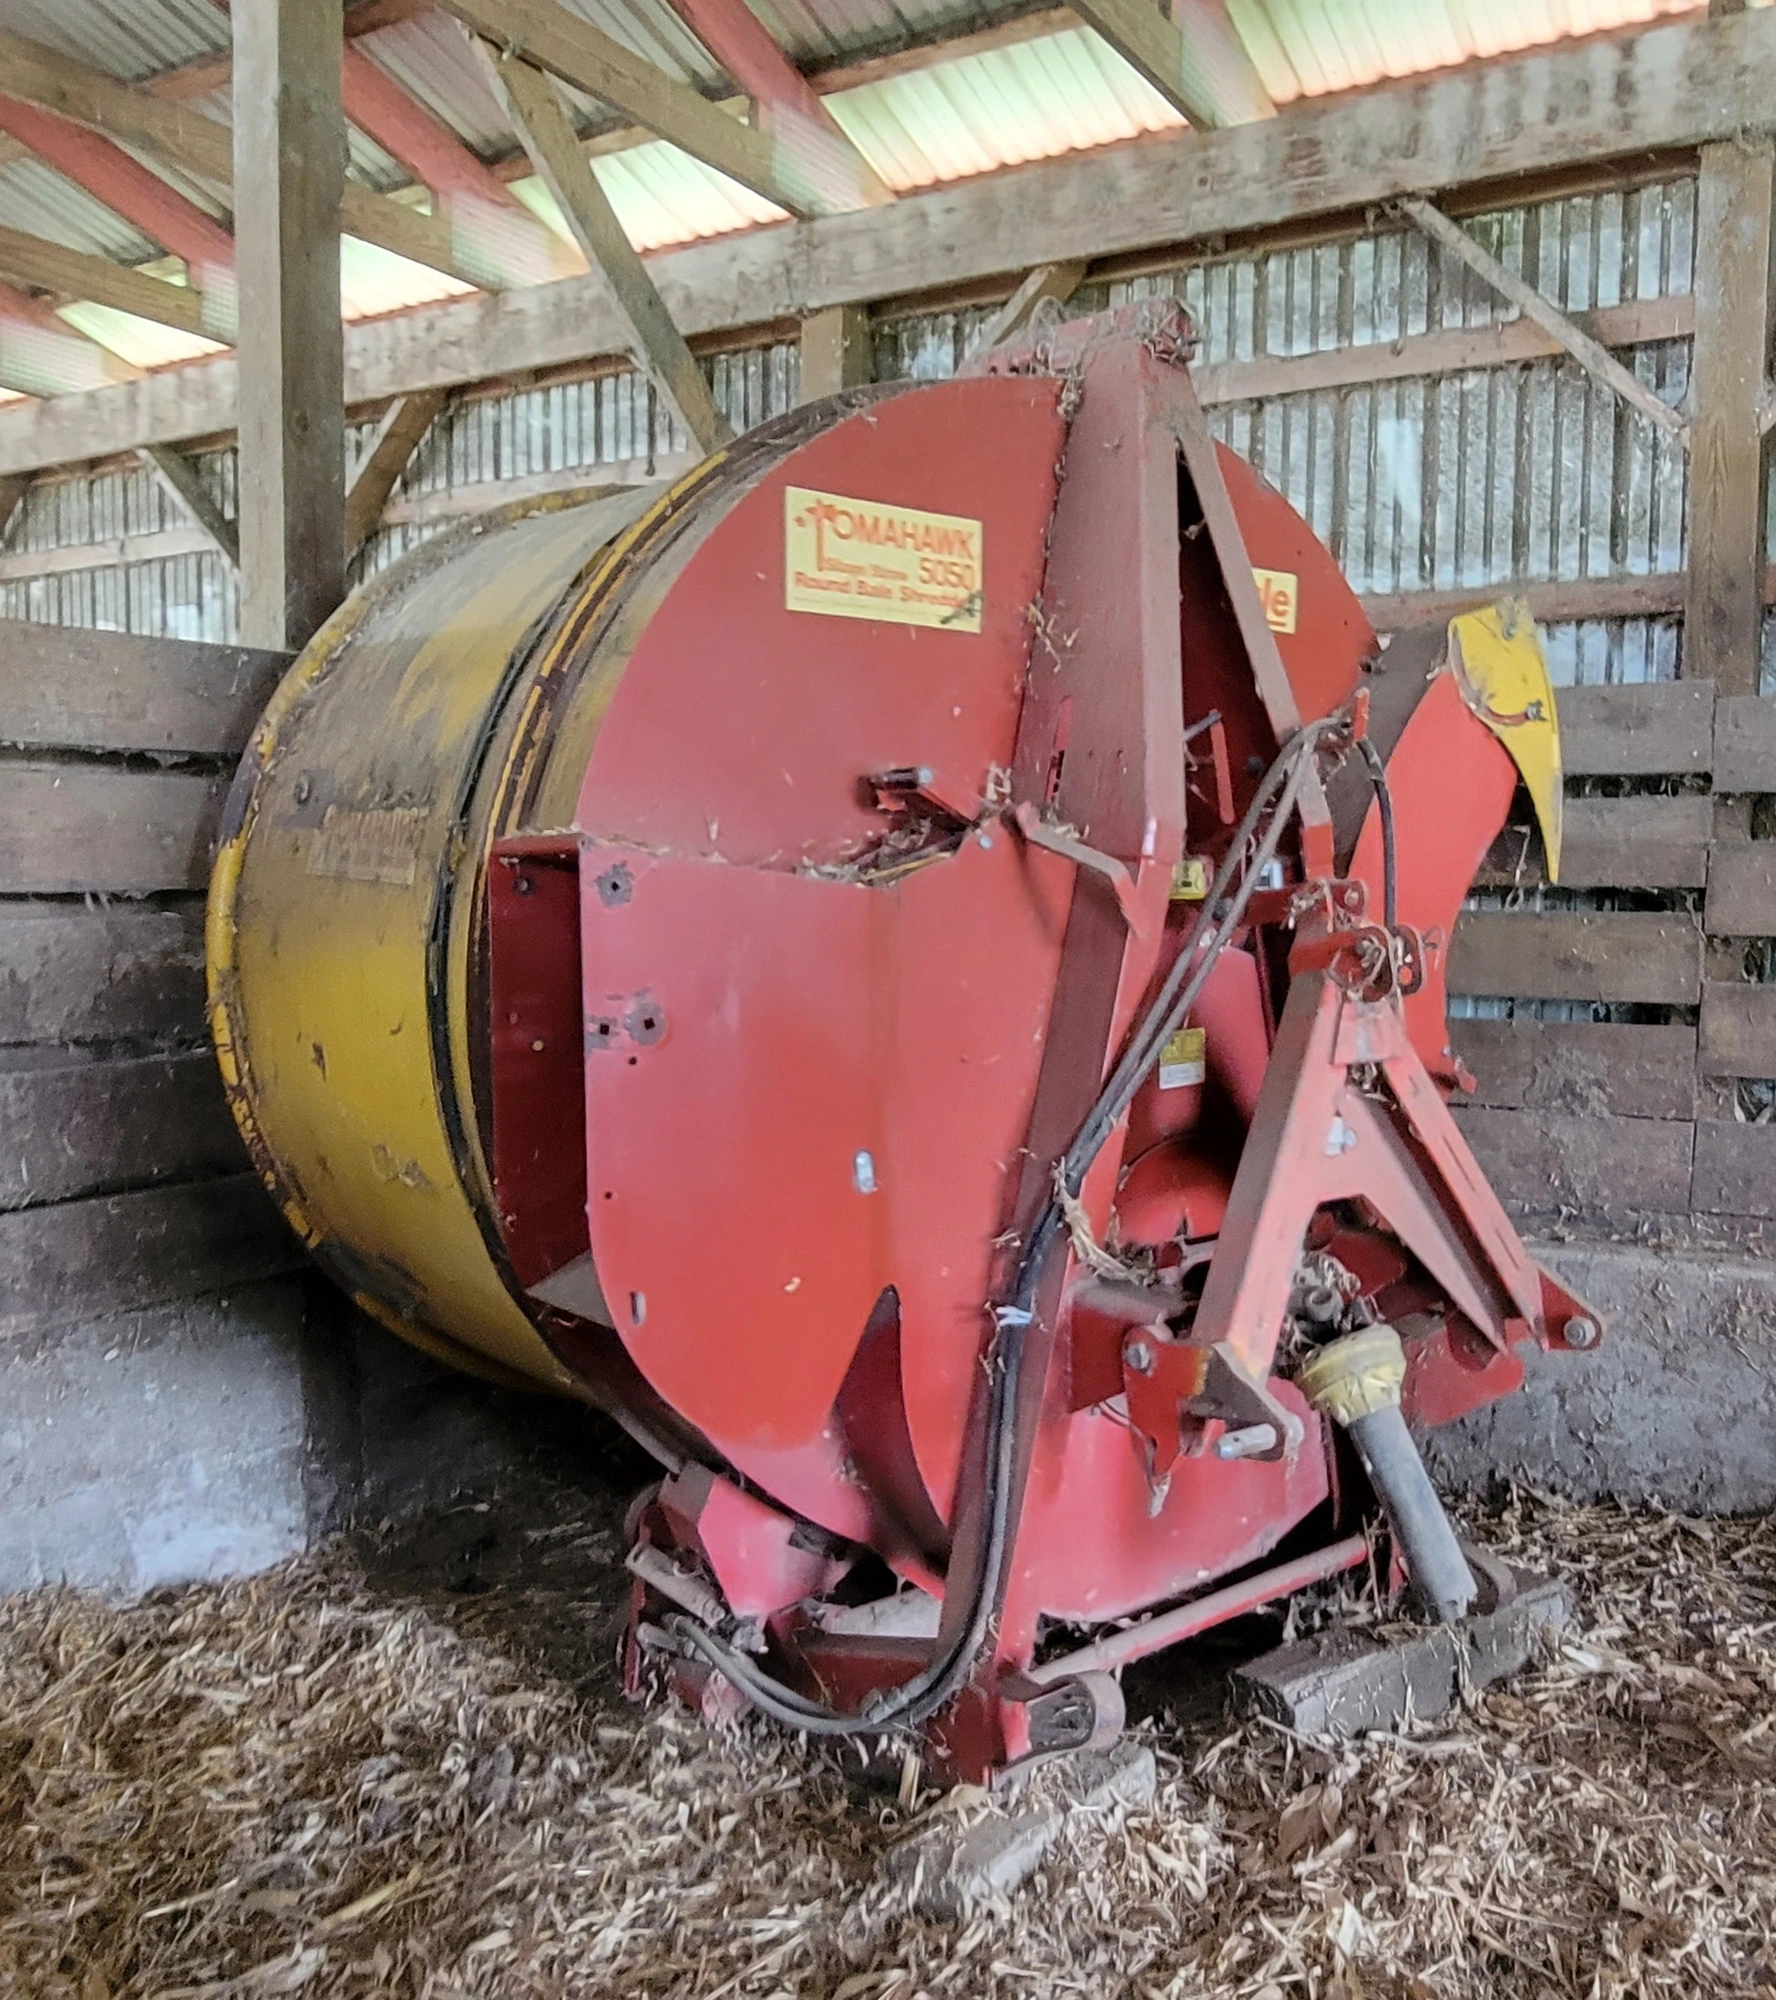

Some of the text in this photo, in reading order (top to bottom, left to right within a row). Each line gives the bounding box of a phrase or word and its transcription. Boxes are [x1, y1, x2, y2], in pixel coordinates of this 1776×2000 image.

[806, 499, 974, 571] TOMAHAWK
[919, 556, 974, 591] 5050
[1257, 577, 1290, 618] le
